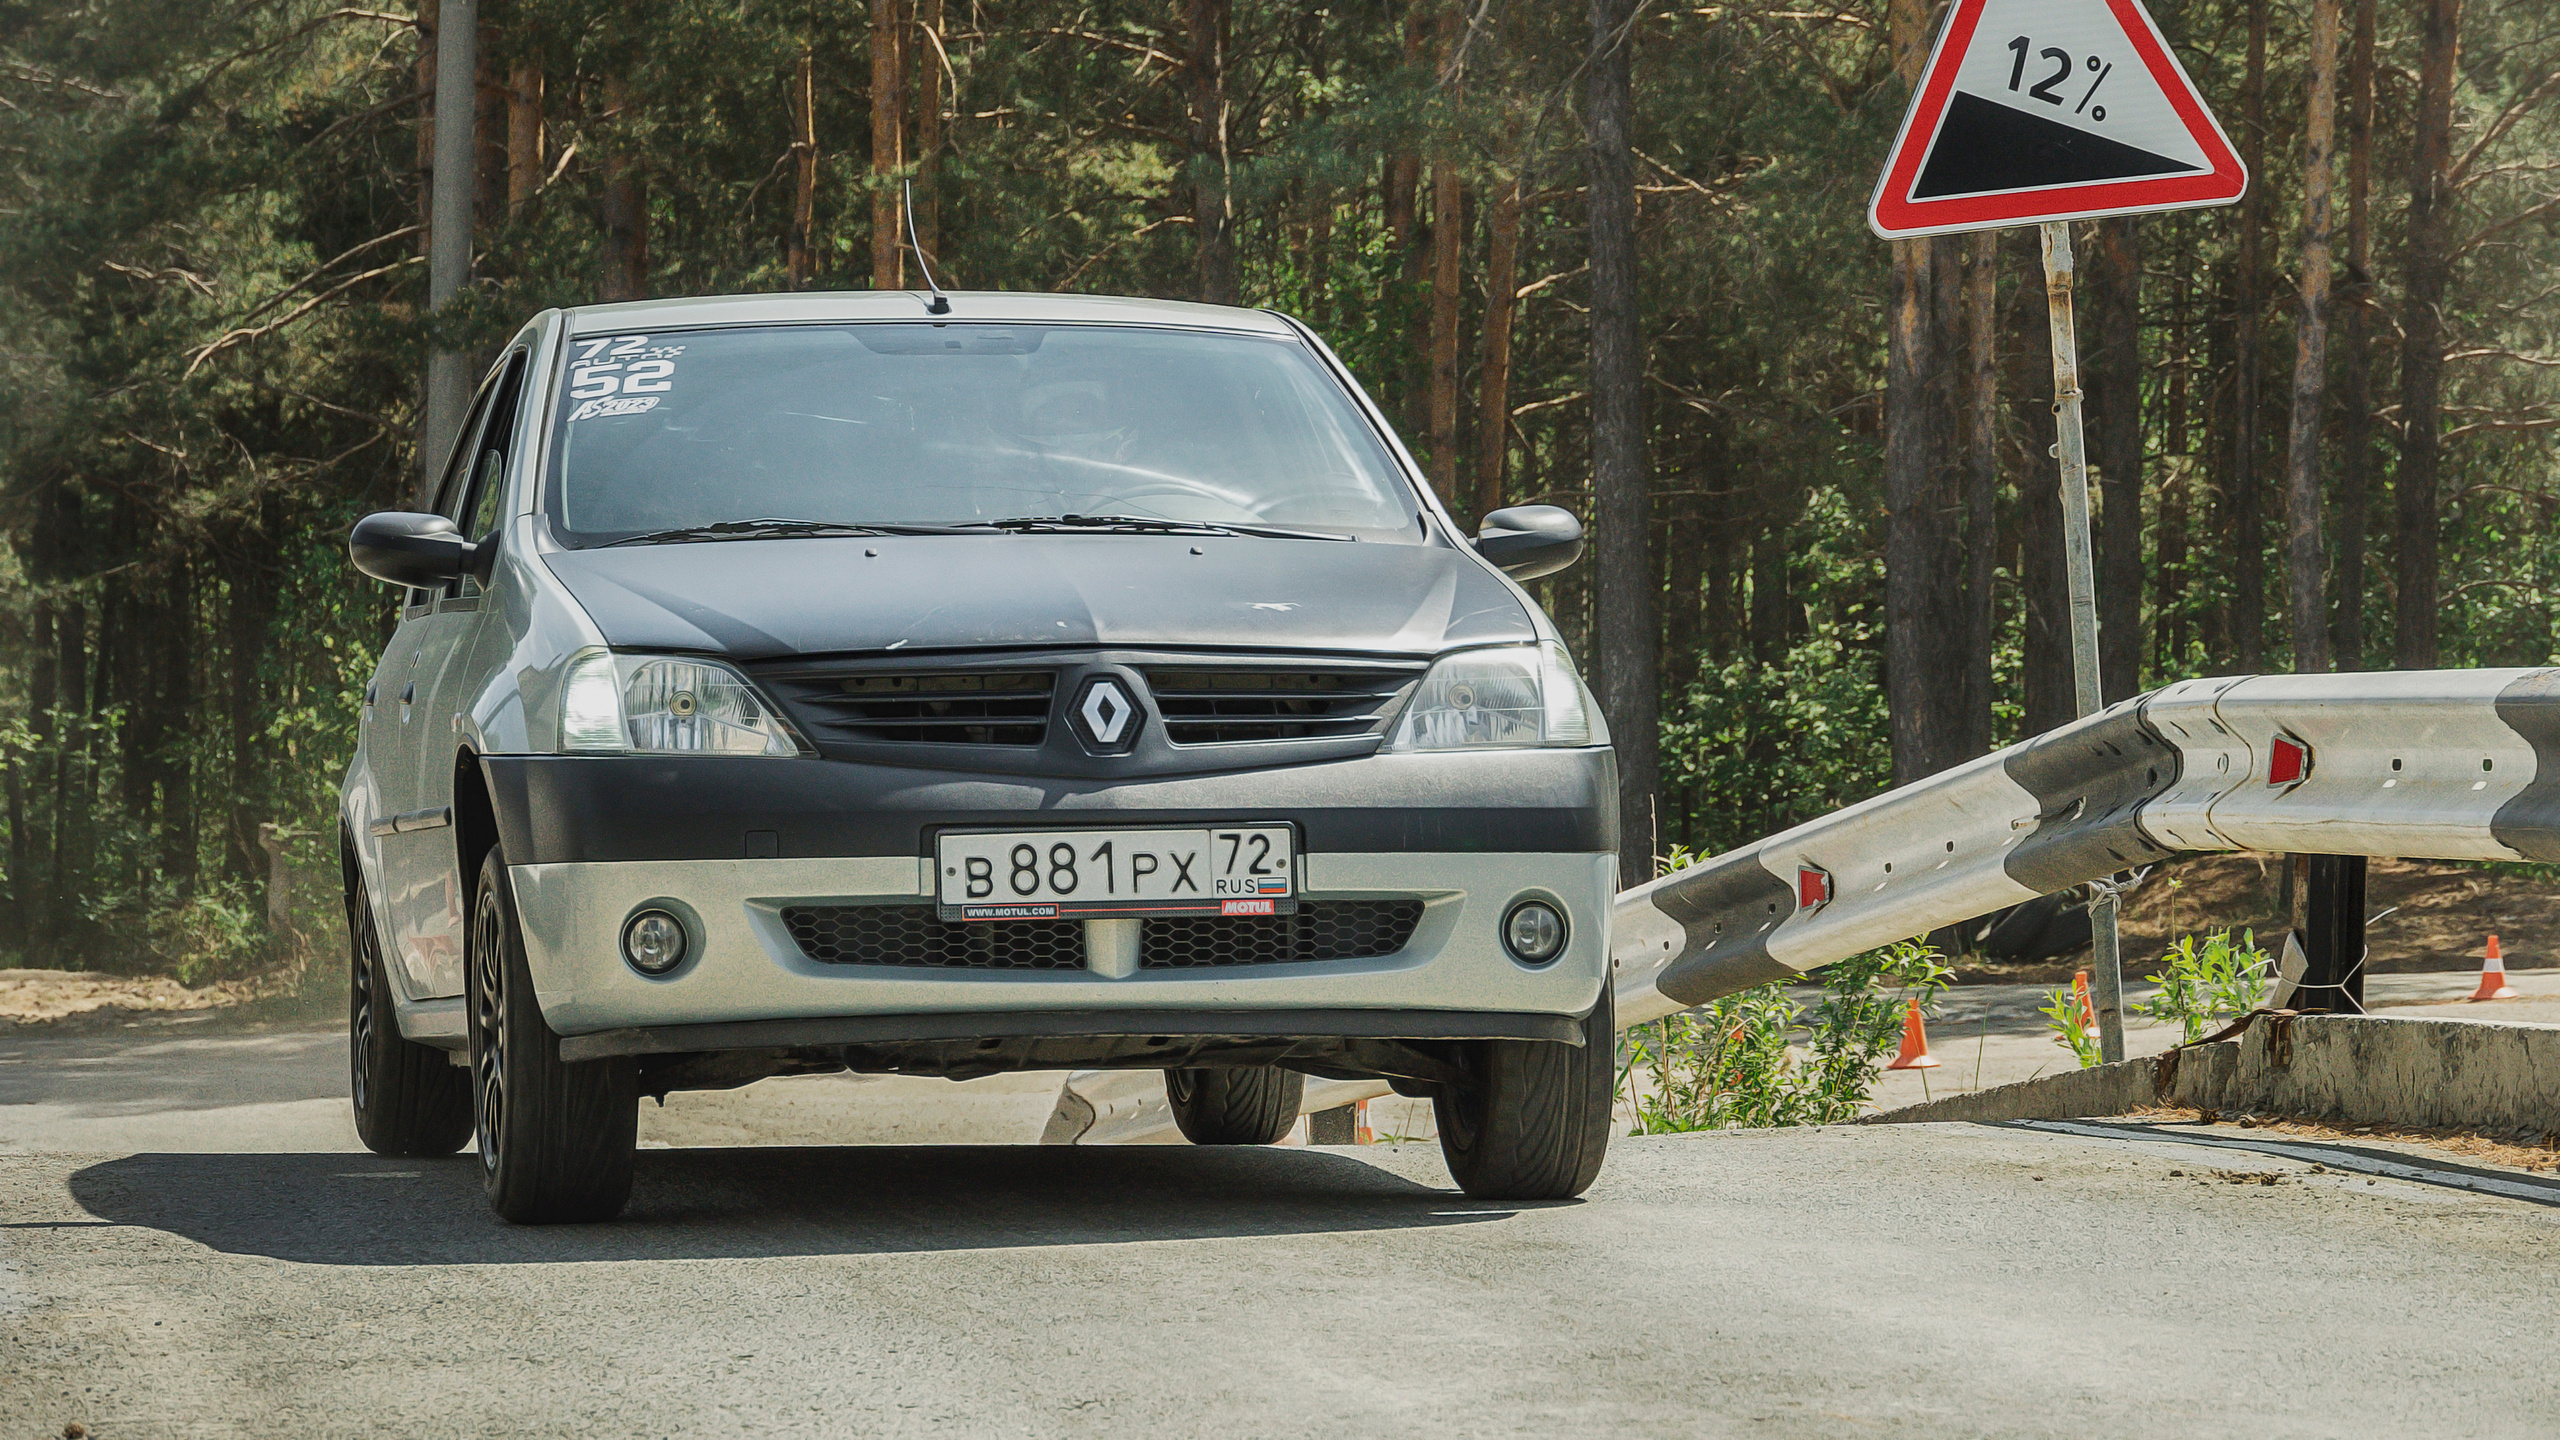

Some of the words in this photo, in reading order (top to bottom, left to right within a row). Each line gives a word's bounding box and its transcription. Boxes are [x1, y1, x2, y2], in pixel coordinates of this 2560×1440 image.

[2007, 35, 2113, 122] 12%
[575, 335, 649, 360] 72
[569, 359, 675, 399] 52
[1218, 833, 1272, 875] 72
[1215, 878, 1256, 895] RUS
[966, 904, 1055, 918] WWW.MOTUL.COM
[1223, 900, 1274, 915] MOTUL
